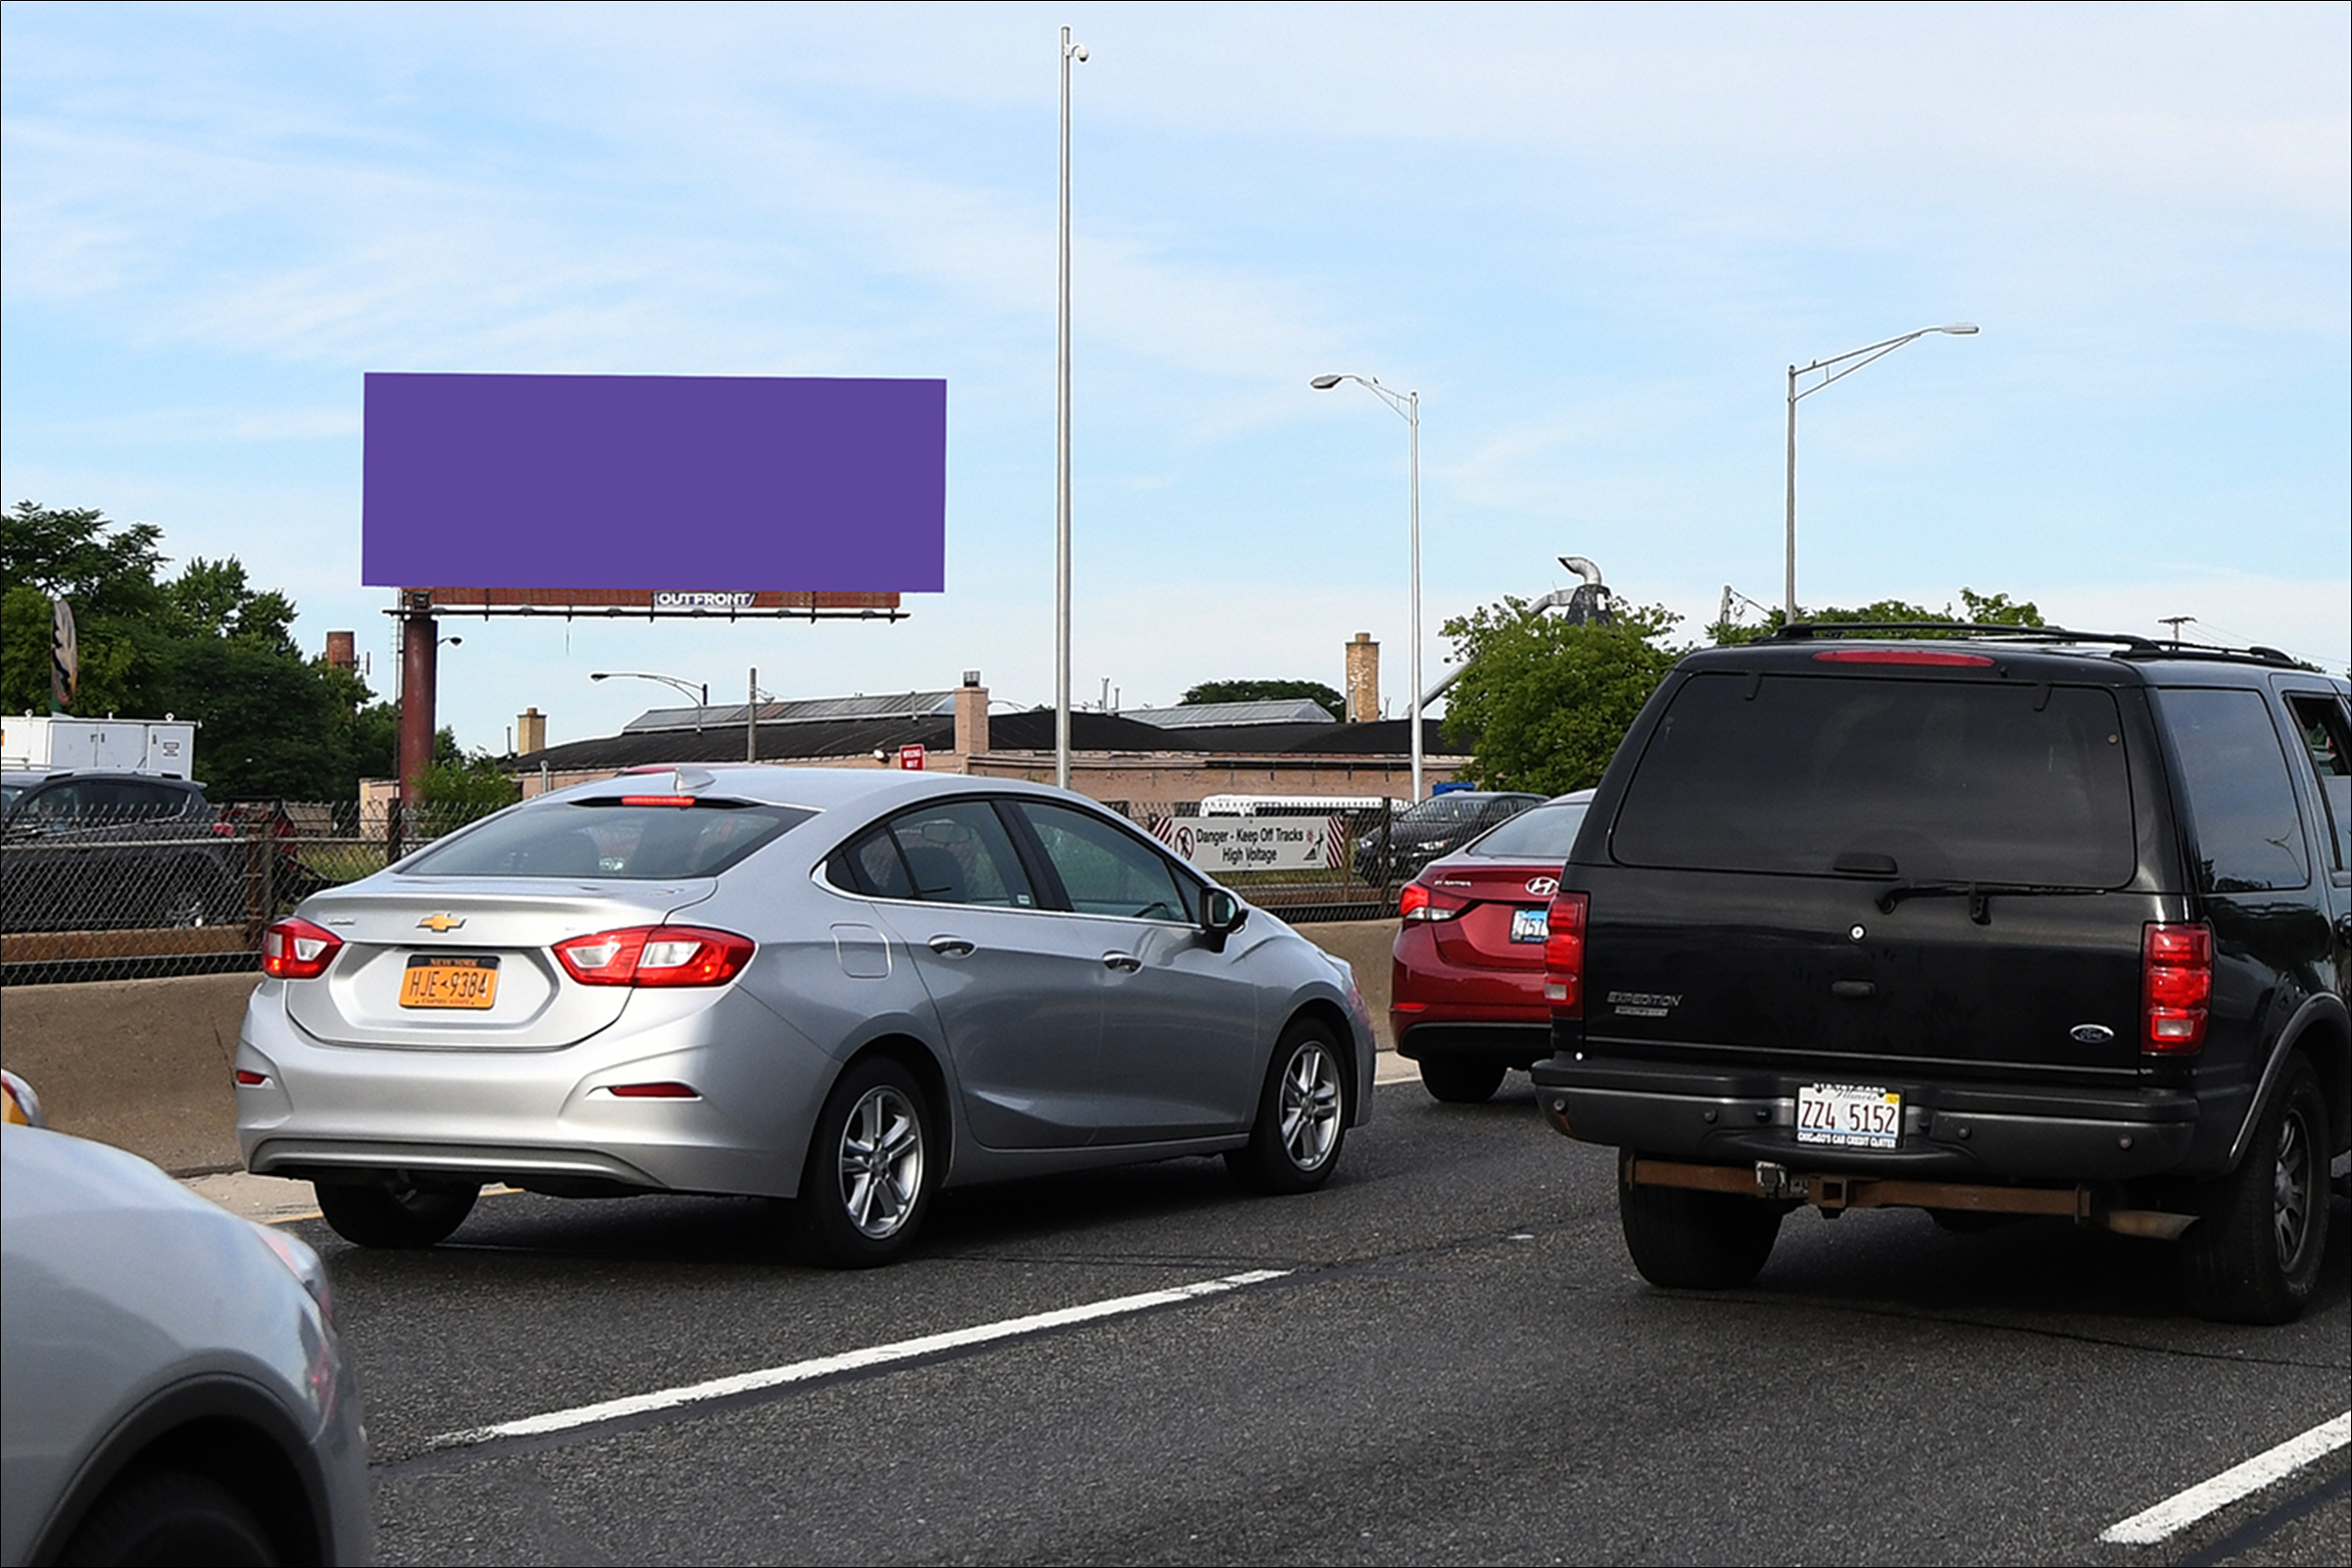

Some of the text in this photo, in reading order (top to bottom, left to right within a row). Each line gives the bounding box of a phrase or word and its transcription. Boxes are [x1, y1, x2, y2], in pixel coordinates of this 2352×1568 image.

[658, 592, 751, 606] OUTFRONT
[1196, 828, 1228, 846] Danger
[1236, 828, 1258, 845] Keep
[1260, 828, 1273, 842] Off
[1275, 827, 1303, 842] Tracks
[1222, 848, 1277, 864] High Voltage
[1607, 991, 1683, 1006] EXPEDITION
[1801, 1100, 1896, 1134] ZZ4 5152
